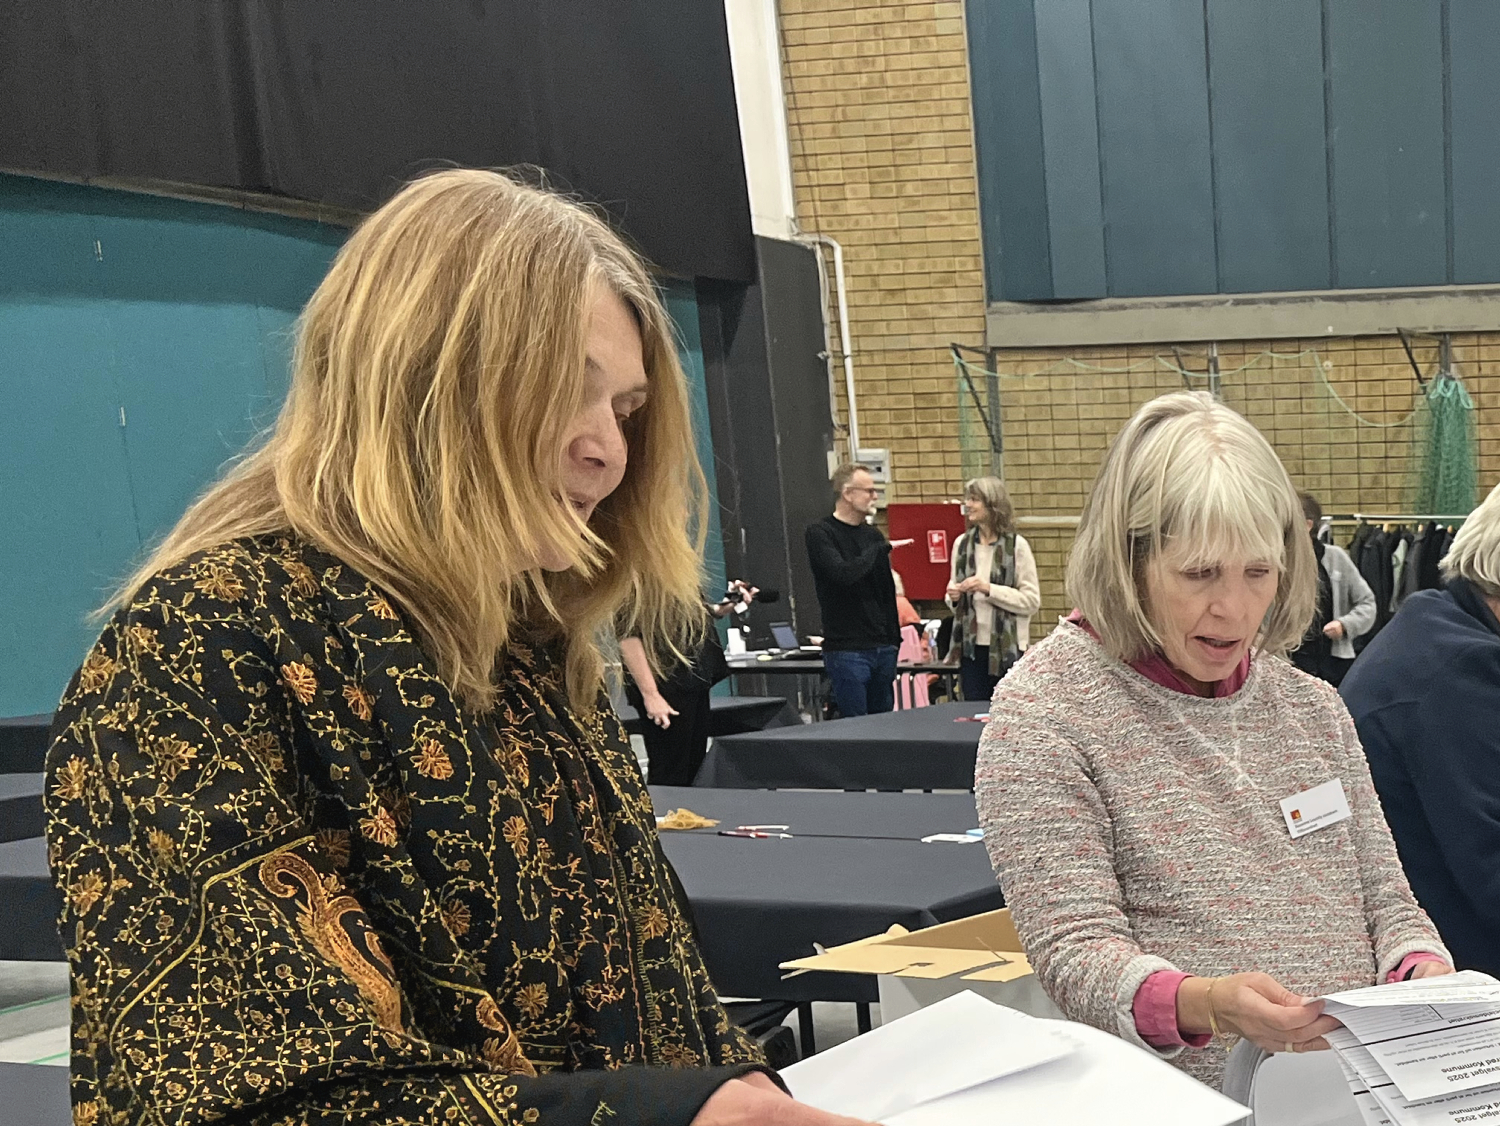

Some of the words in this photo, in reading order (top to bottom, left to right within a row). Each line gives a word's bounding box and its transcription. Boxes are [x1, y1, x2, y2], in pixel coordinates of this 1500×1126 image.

[1441, 1061, 1484, 1073] Kommune
[1447, 1073, 1469, 1082] 2025
[1448, 1104, 1492, 1115] Kommune
[1454, 1115, 1477, 1123] 2025
